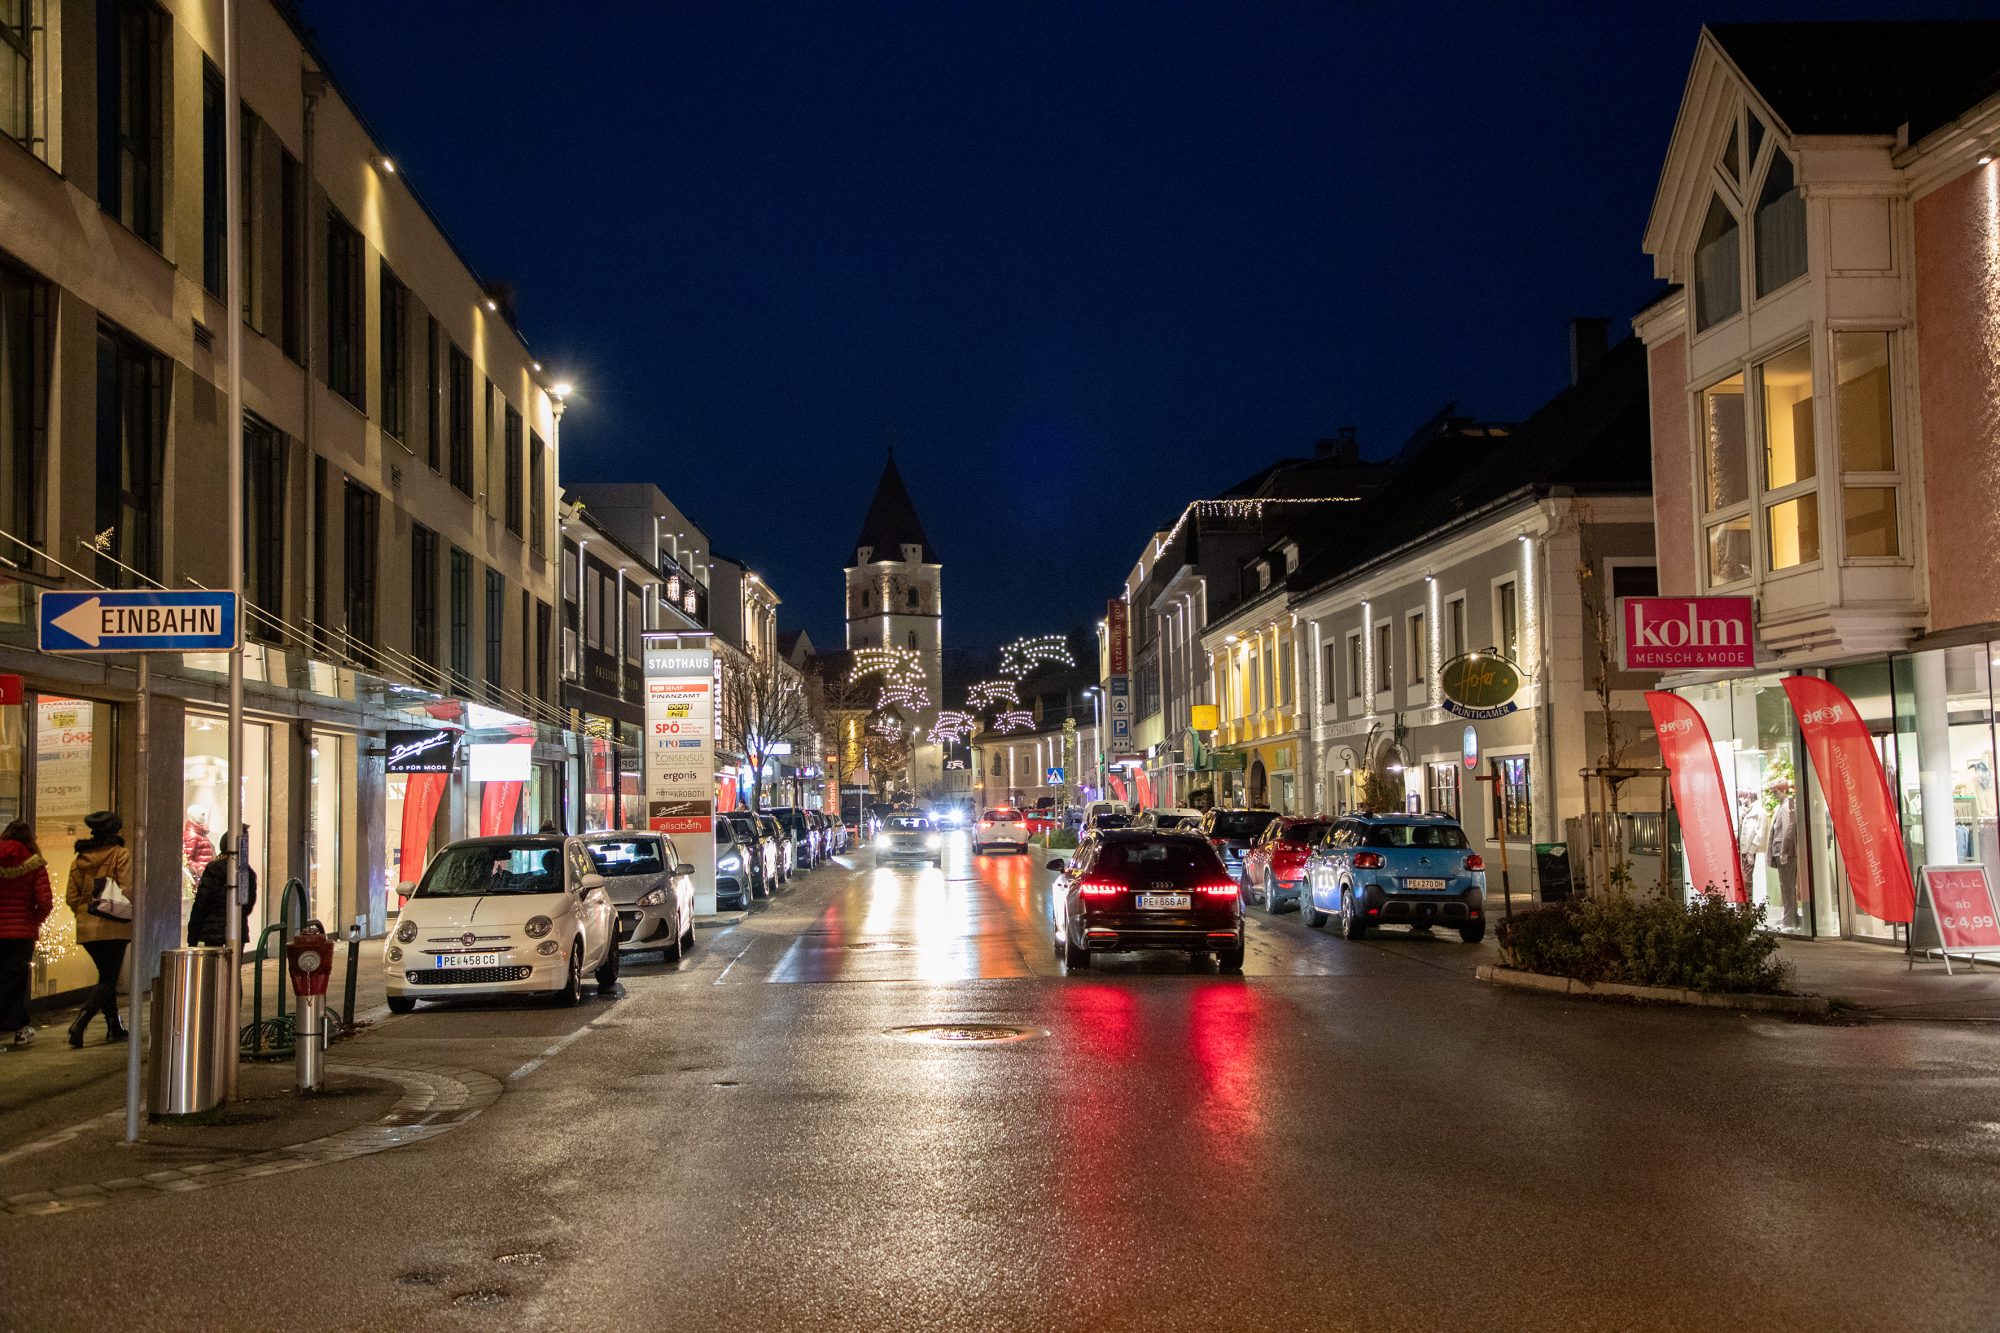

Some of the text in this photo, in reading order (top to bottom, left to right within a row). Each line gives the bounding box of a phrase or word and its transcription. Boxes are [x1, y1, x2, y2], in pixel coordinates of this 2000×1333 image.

[101, 608, 216, 635] EINBAHN
[1630, 602, 1748, 647] kolm
[1635, 651, 1745, 664] MENSCH & MODE
[648, 658, 709, 669] STADTHAUS
[1452, 704, 1510, 719] PUNTIGAMER
[655, 721, 680, 733] SPÖ
[656, 754, 704, 763] CONSENSUS
[663, 771, 697, 782] ergonis
[660, 821, 702, 830] elisabeth
[1934, 879, 1982, 889] SALE
[1143, 897, 1187, 906] PE 666 AP
[1955, 898, 1971, 909] ab
[1943, 915, 1994, 930] € 4,99
[444, 956, 456, 966] PE
[463, 955, 481, 965] 458
